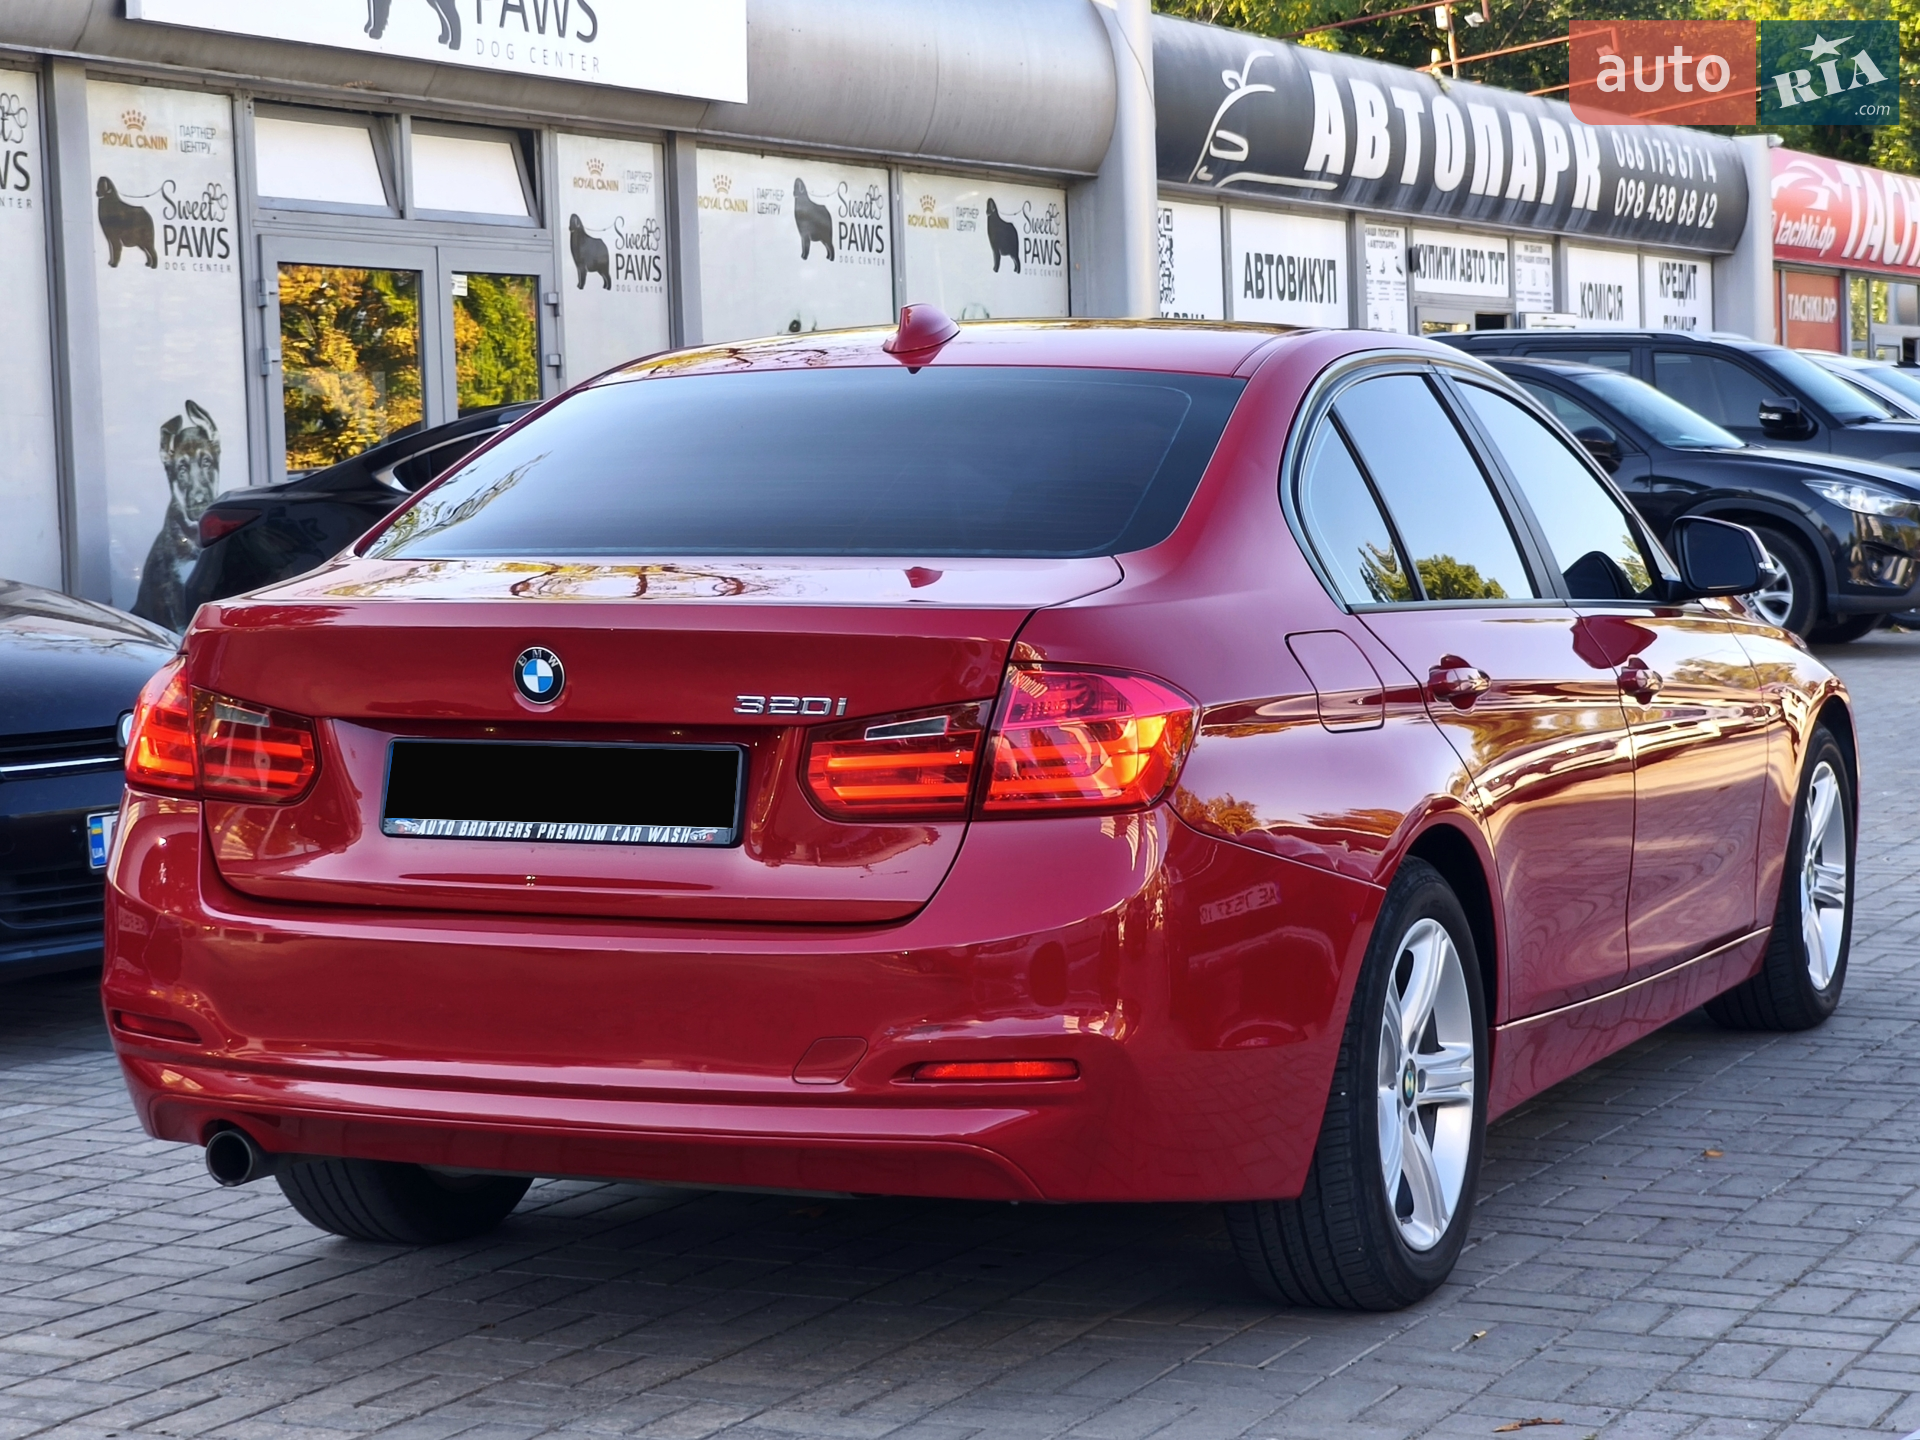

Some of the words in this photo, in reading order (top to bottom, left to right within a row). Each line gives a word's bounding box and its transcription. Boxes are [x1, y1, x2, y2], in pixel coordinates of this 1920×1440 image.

[476, 38, 515, 60] DOG
[529, 47, 600, 74] CENTER
[102, 131, 134, 149] ROYAL
[136, 133, 168, 151] CANIN
[179, 125, 216, 140] ПАРТНЕР
[1304, 70, 1601, 212] АВТОПАРК
[1611, 130, 1645, 171] 066
[161, 179, 216, 222] Sweet
[573, 177, 596, 190] ROYAL
[596, 178, 619, 192] CANIN
[837, 181, 875, 220] Sweet
[698, 196, 722, 211] ROYAL
[723, 197, 749, 213] CANIN
[1022, 200, 1055, 235] Sweet
[1614, 177, 1646, 219] 098
[1646, 183, 1677, 223] 438
[1677, 188, 1698, 227] 68
[1698, 191, 1718, 229] 62
[1834, 164, 1920, 268] TACH
[614, 215, 652, 251] Sweet
[838, 222, 885, 254] PAWS
[907, 214, 928, 228] ROYAL
[928, 215, 949, 229] CANIN
[163, 224, 231, 259] PAWS
[1023, 238, 1062, 266] PAWS
[164, 262, 187, 271] DOG
[192, 262, 232, 273] CENTER
[615, 253, 662, 282] PAWS
[839, 255, 855, 264] DOG
[1459, 248, 1486, 284] АВТО
[1488, 250, 1505, 285] ТУТ
[1243, 252, 1338, 304] АВТОВИКУП
[1659, 261, 1697, 307] КРЕДИТ
[1580, 281, 1624, 321] КОМІСІЯ
[518, 649, 559, 668] BMW
[733, 695, 847, 716] 320i
[416, 819, 454, 836] AUTO
[458, 820, 534, 838] BROTHERS
[536, 823, 608, 841] PREMIUM
[611, 825, 642, 842] CAR
[647, 826, 691, 843] WASH
